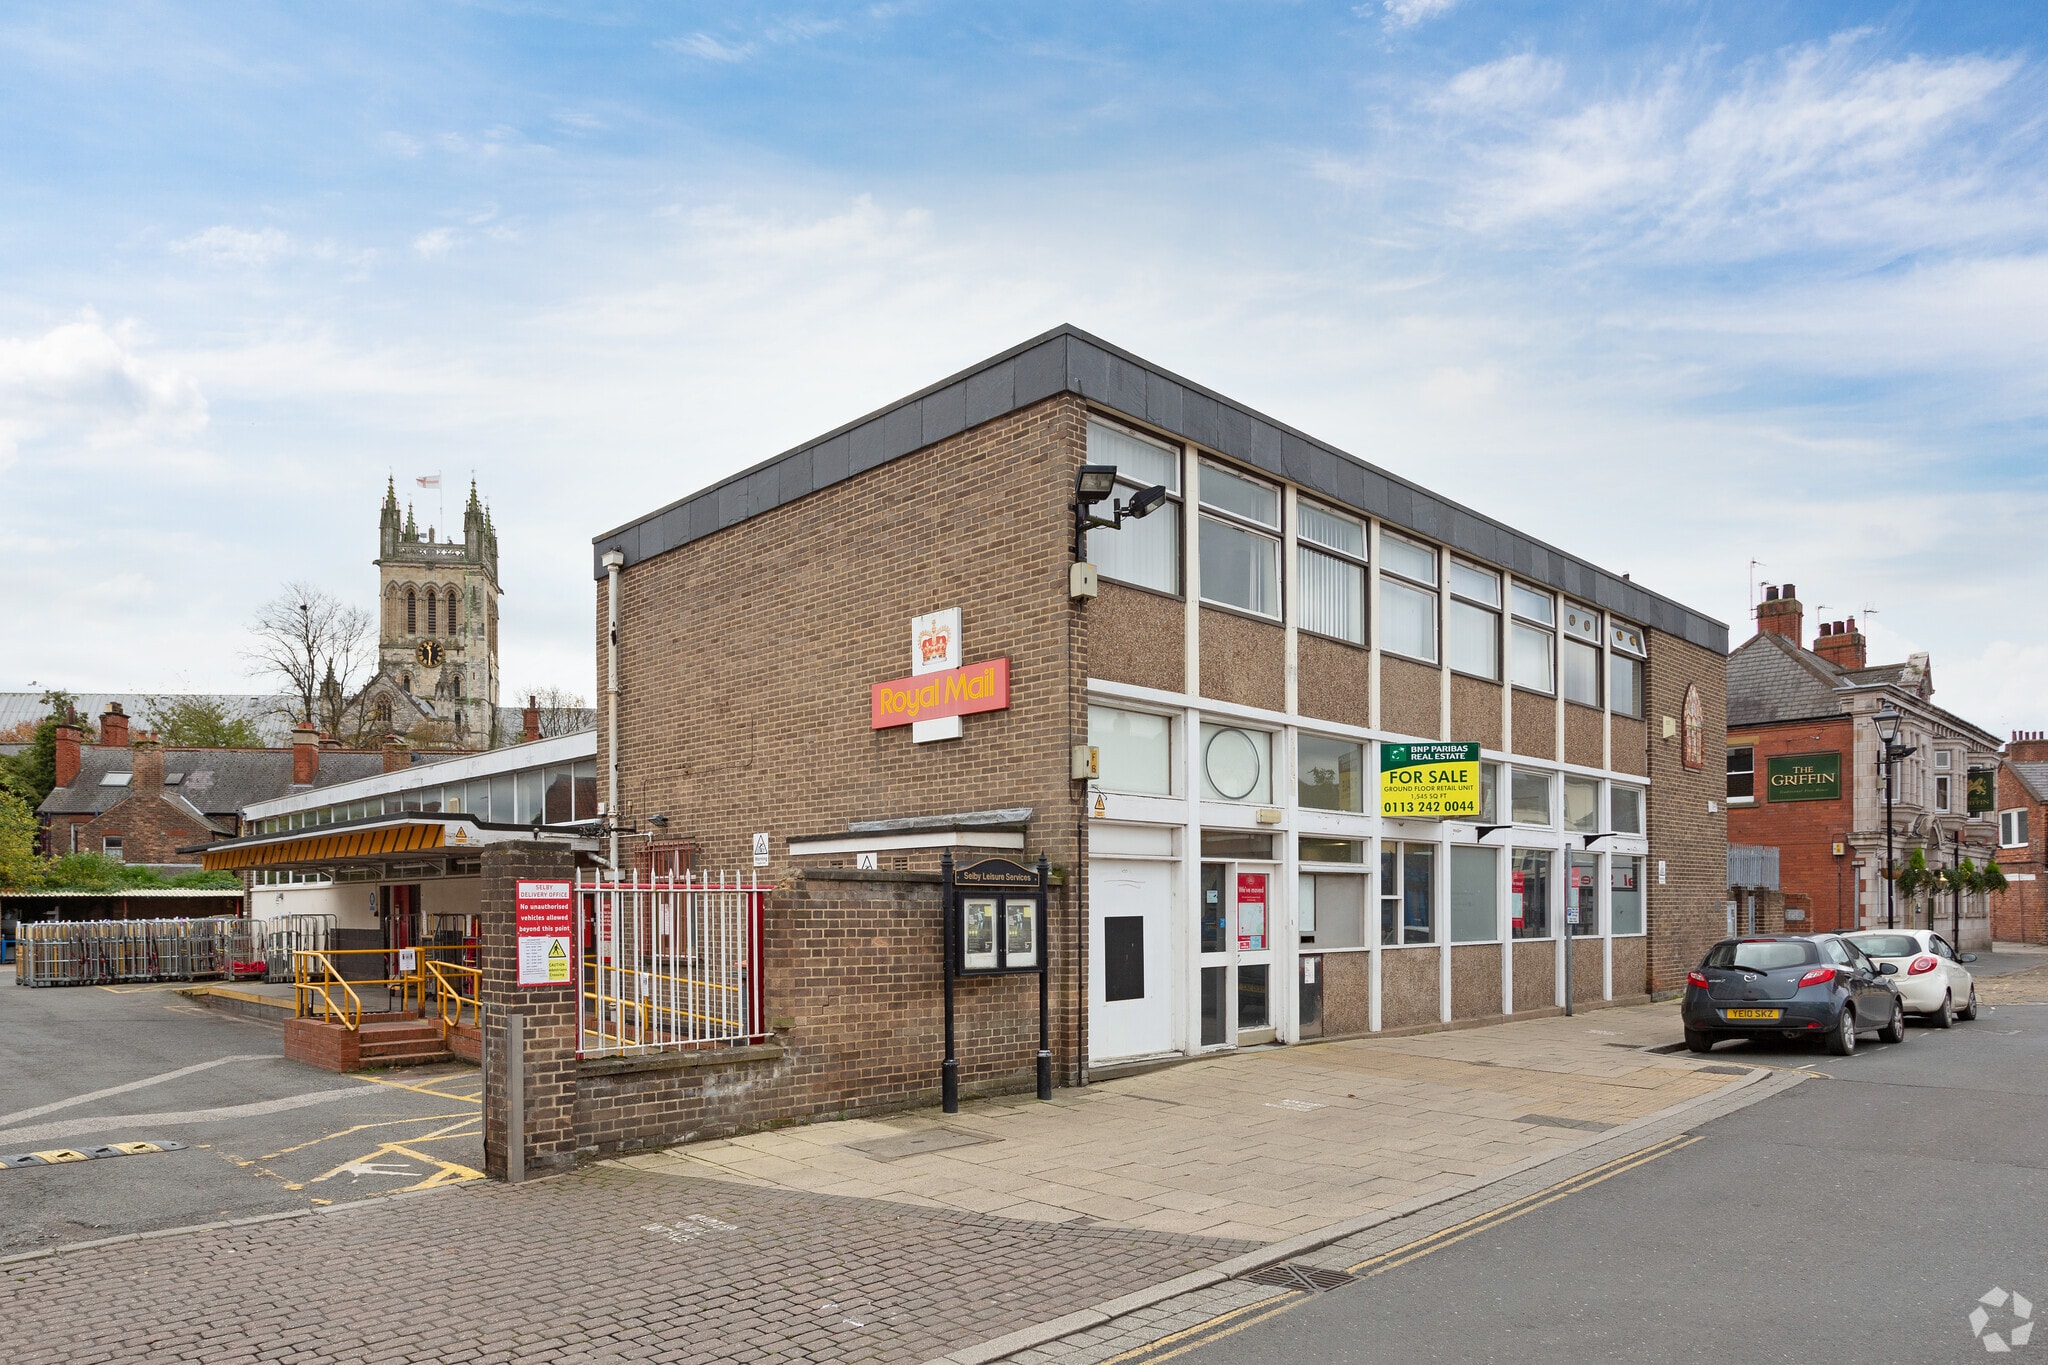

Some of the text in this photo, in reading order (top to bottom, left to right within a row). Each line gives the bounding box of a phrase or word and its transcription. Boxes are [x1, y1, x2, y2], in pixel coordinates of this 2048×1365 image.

[881, 667, 995, 717] Royal Mail
[1431, 745, 1468, 753] PARIBAS
[1390, 770, 1468, 784] FOR SALE
[1771, 773, 1835, 786] GRIFFIN
[1384, 801, 1474, 812] 0113 242 0044
[964, 872, 1031, 882] Selby Leisure Services
[1732, 1010, 1774, 1018] YE10 SKZ
